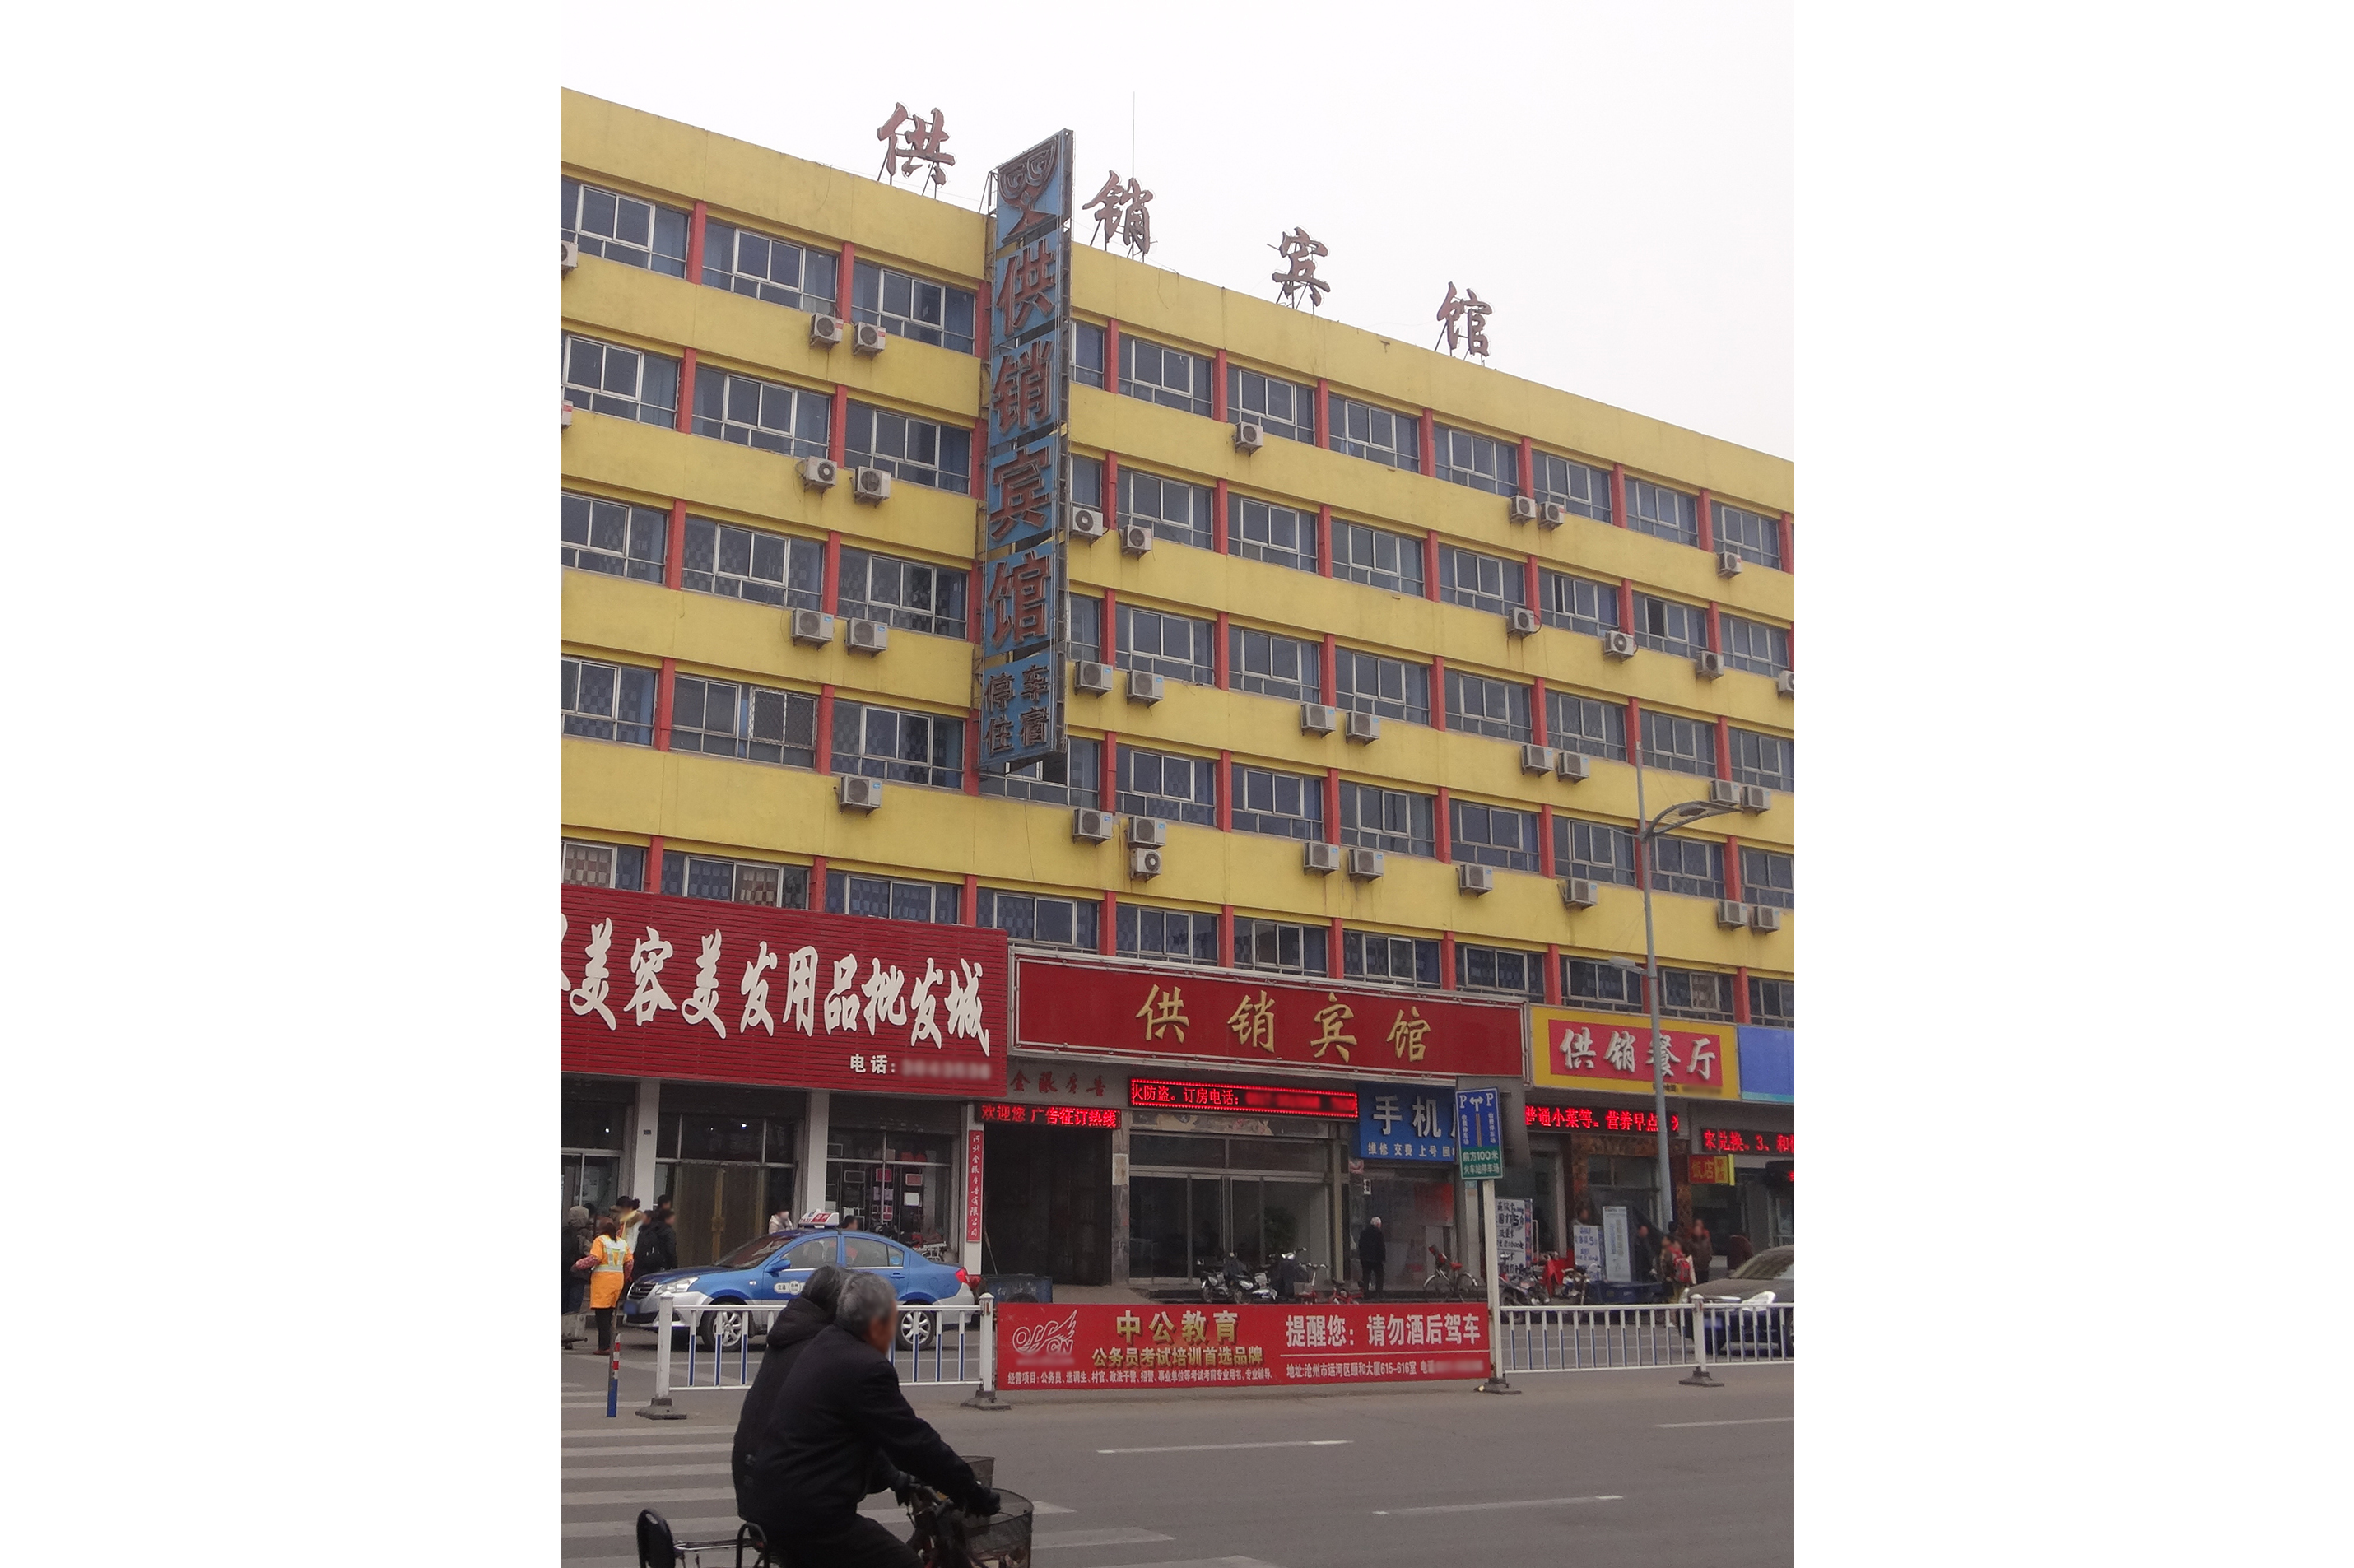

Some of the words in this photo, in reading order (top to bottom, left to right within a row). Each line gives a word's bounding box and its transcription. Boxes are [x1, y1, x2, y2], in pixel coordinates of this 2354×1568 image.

[877, 102, 1495, 358] 供销宾馆
[987, 237, 1058, 649] 供销宾馆
[561, 913, 990, 1056] 美容美发用品批发城
[1135, 984, 1432, 1063] 供销宾馆
[1560, 1027, 1716, 1082] 供销餐厅
[981, 1103, 1026, 1123] 欢迎您
[1030, 1106, 1117, 1128] 广告征订热线
[1373, 1095, 1456, 1138] 手机
[1459, 1095, 1467, 1109] P
[1486, 1092, 1494, 1106] P
[1418, 1144, 1437, 1157] 上号
[1116, 1310, 1239, 1346] 中公教育
[1091, 1345, 1265, 1369] 公务员考试培训首选品牌
